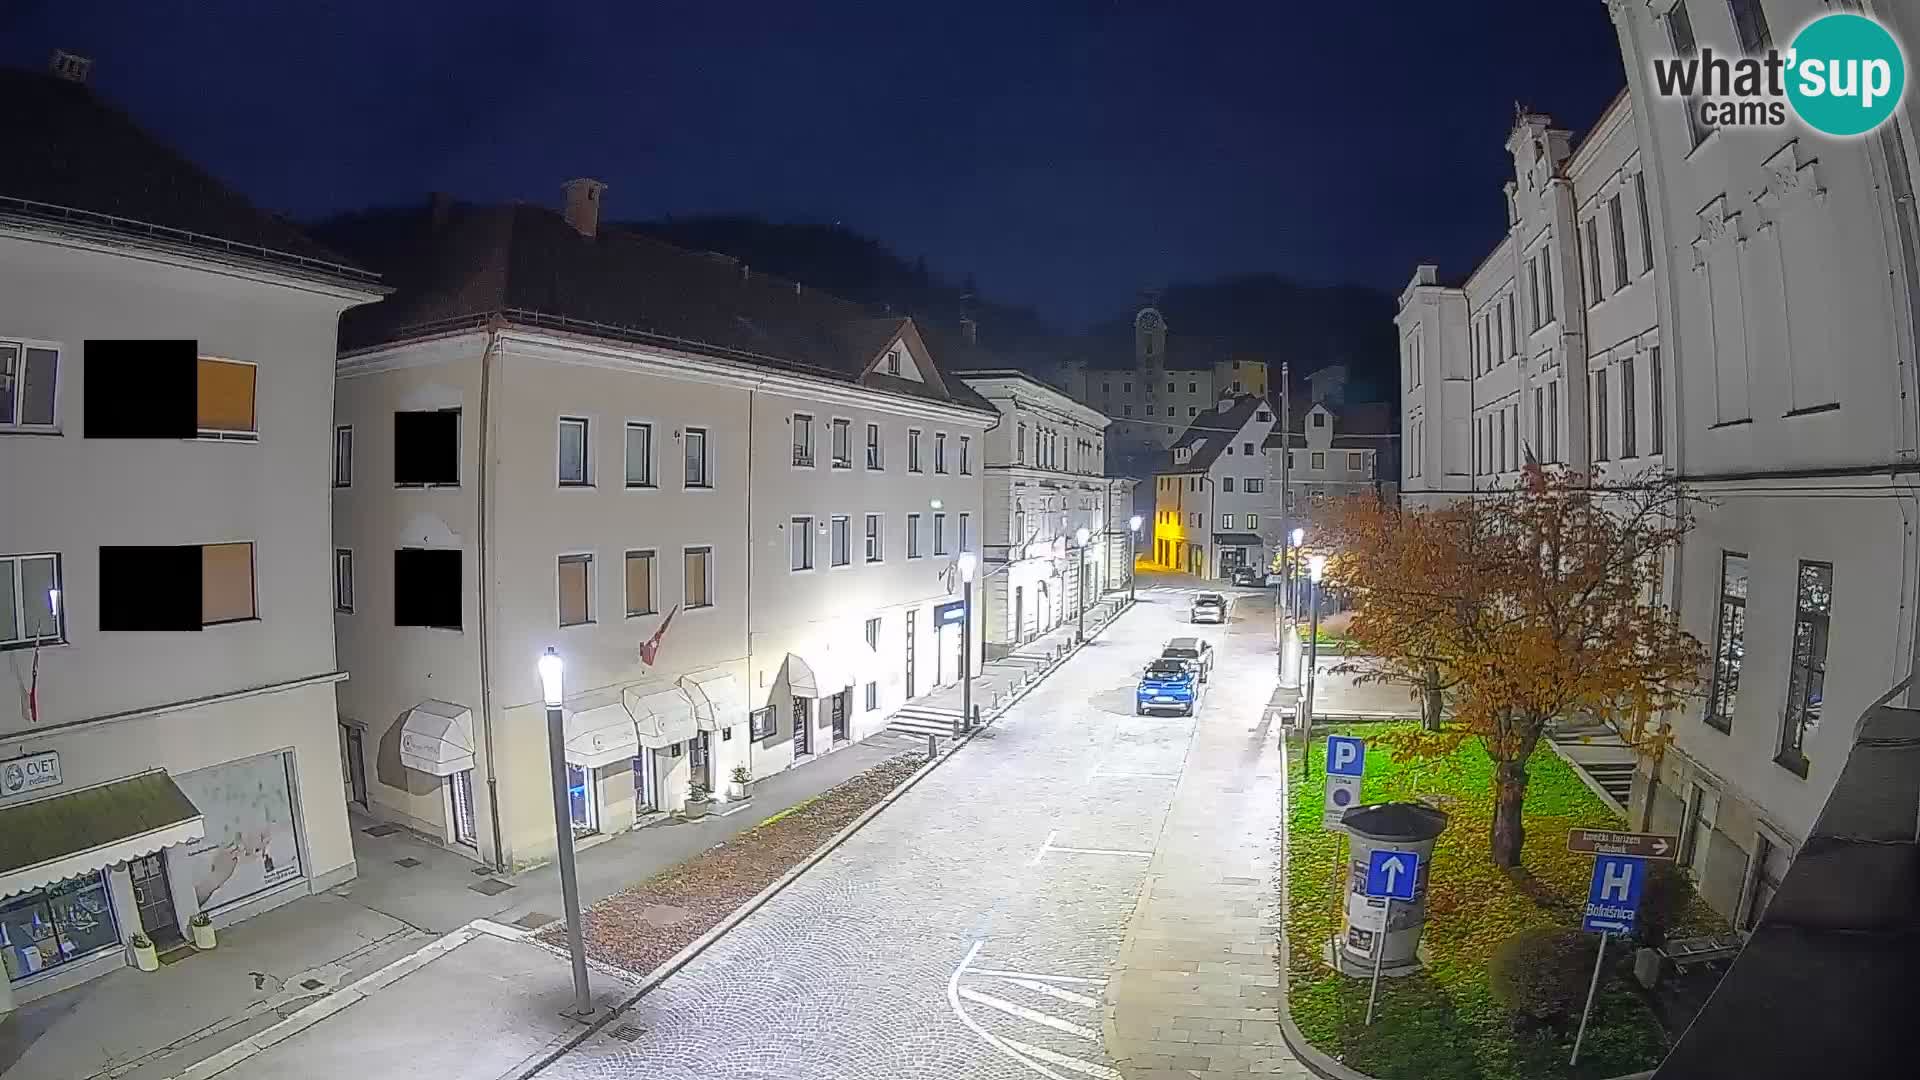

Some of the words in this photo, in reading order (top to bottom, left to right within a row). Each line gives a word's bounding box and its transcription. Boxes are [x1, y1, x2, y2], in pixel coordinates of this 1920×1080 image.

[26, 758, 56, 776] CVET
[1334, 741, 1356, 770] P
[1600, 861, 1633, 902] H
[1586, 902, 1635, 920] Bolnišnica
